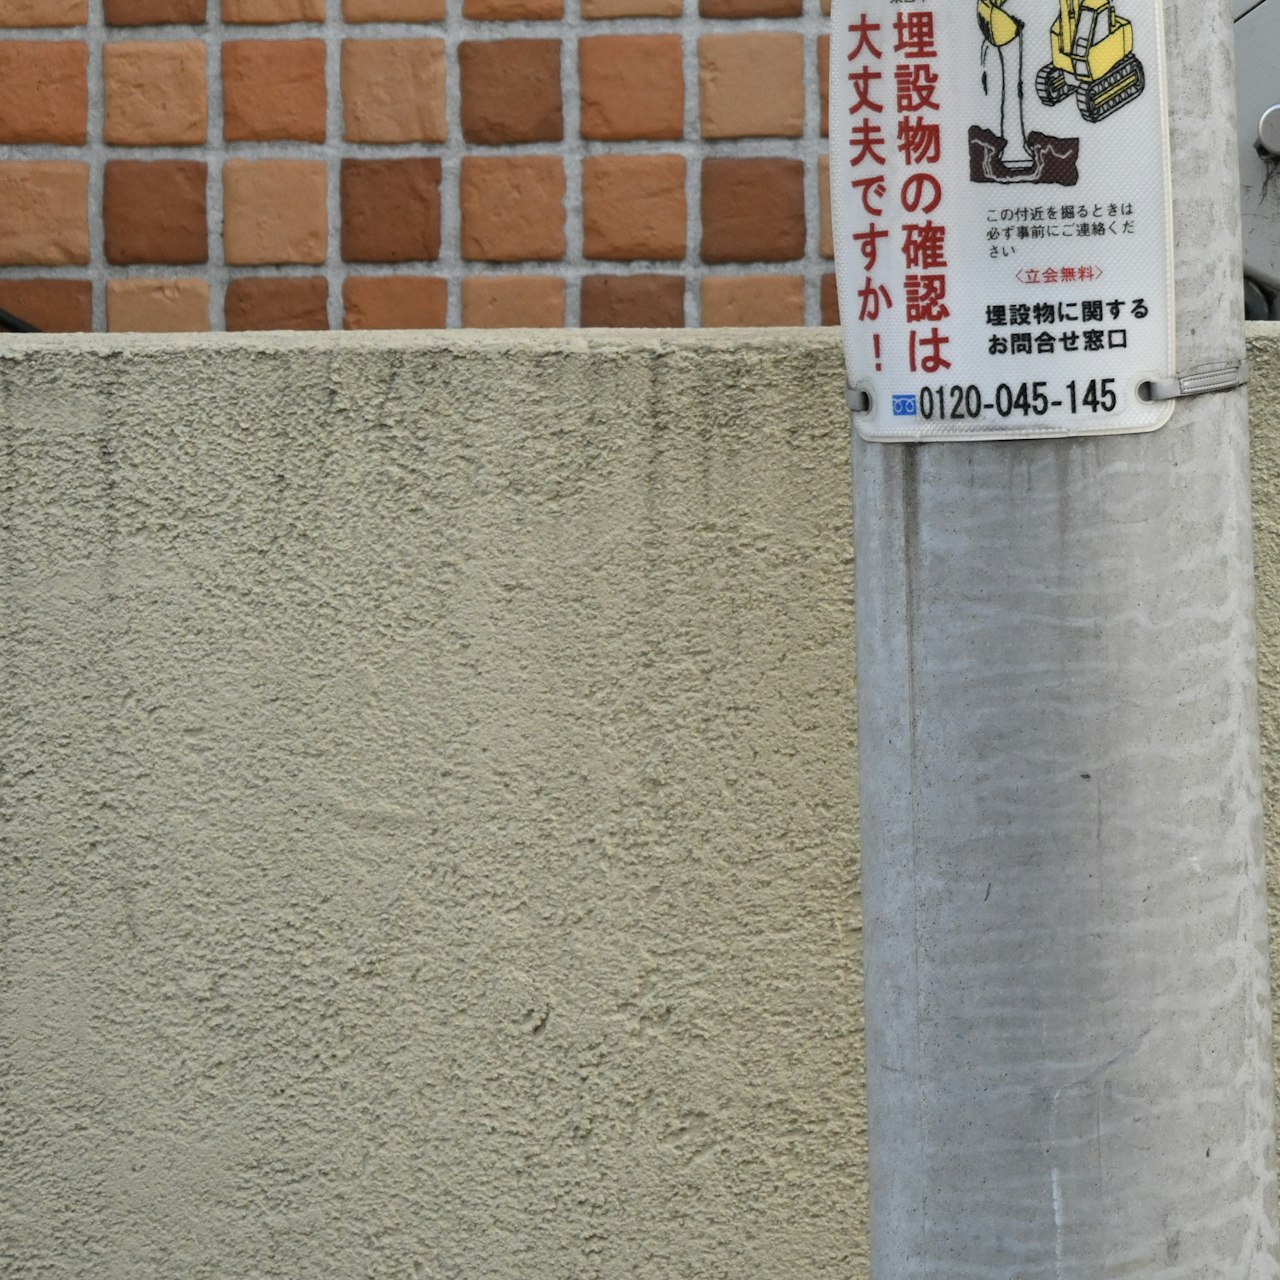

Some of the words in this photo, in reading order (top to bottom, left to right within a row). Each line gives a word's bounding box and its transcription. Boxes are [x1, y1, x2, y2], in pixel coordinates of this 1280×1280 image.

[847, 13, 893, 372] 大丈夫ですか！
[893, 11, 953, 373] 埋設物の確認は
[986, 202, 1134, 222] この付近を掘るときは
[986, 220, 1135, 241] 必ず事前にご連絡くだ
[989, 245, 1016, 259] さい
[985, 298, 1149, 327] 埋設物に関する
[988, 329, 1128, 355] お問合せ窓口
[919, 378, 1117, 420] 0120-045-145
